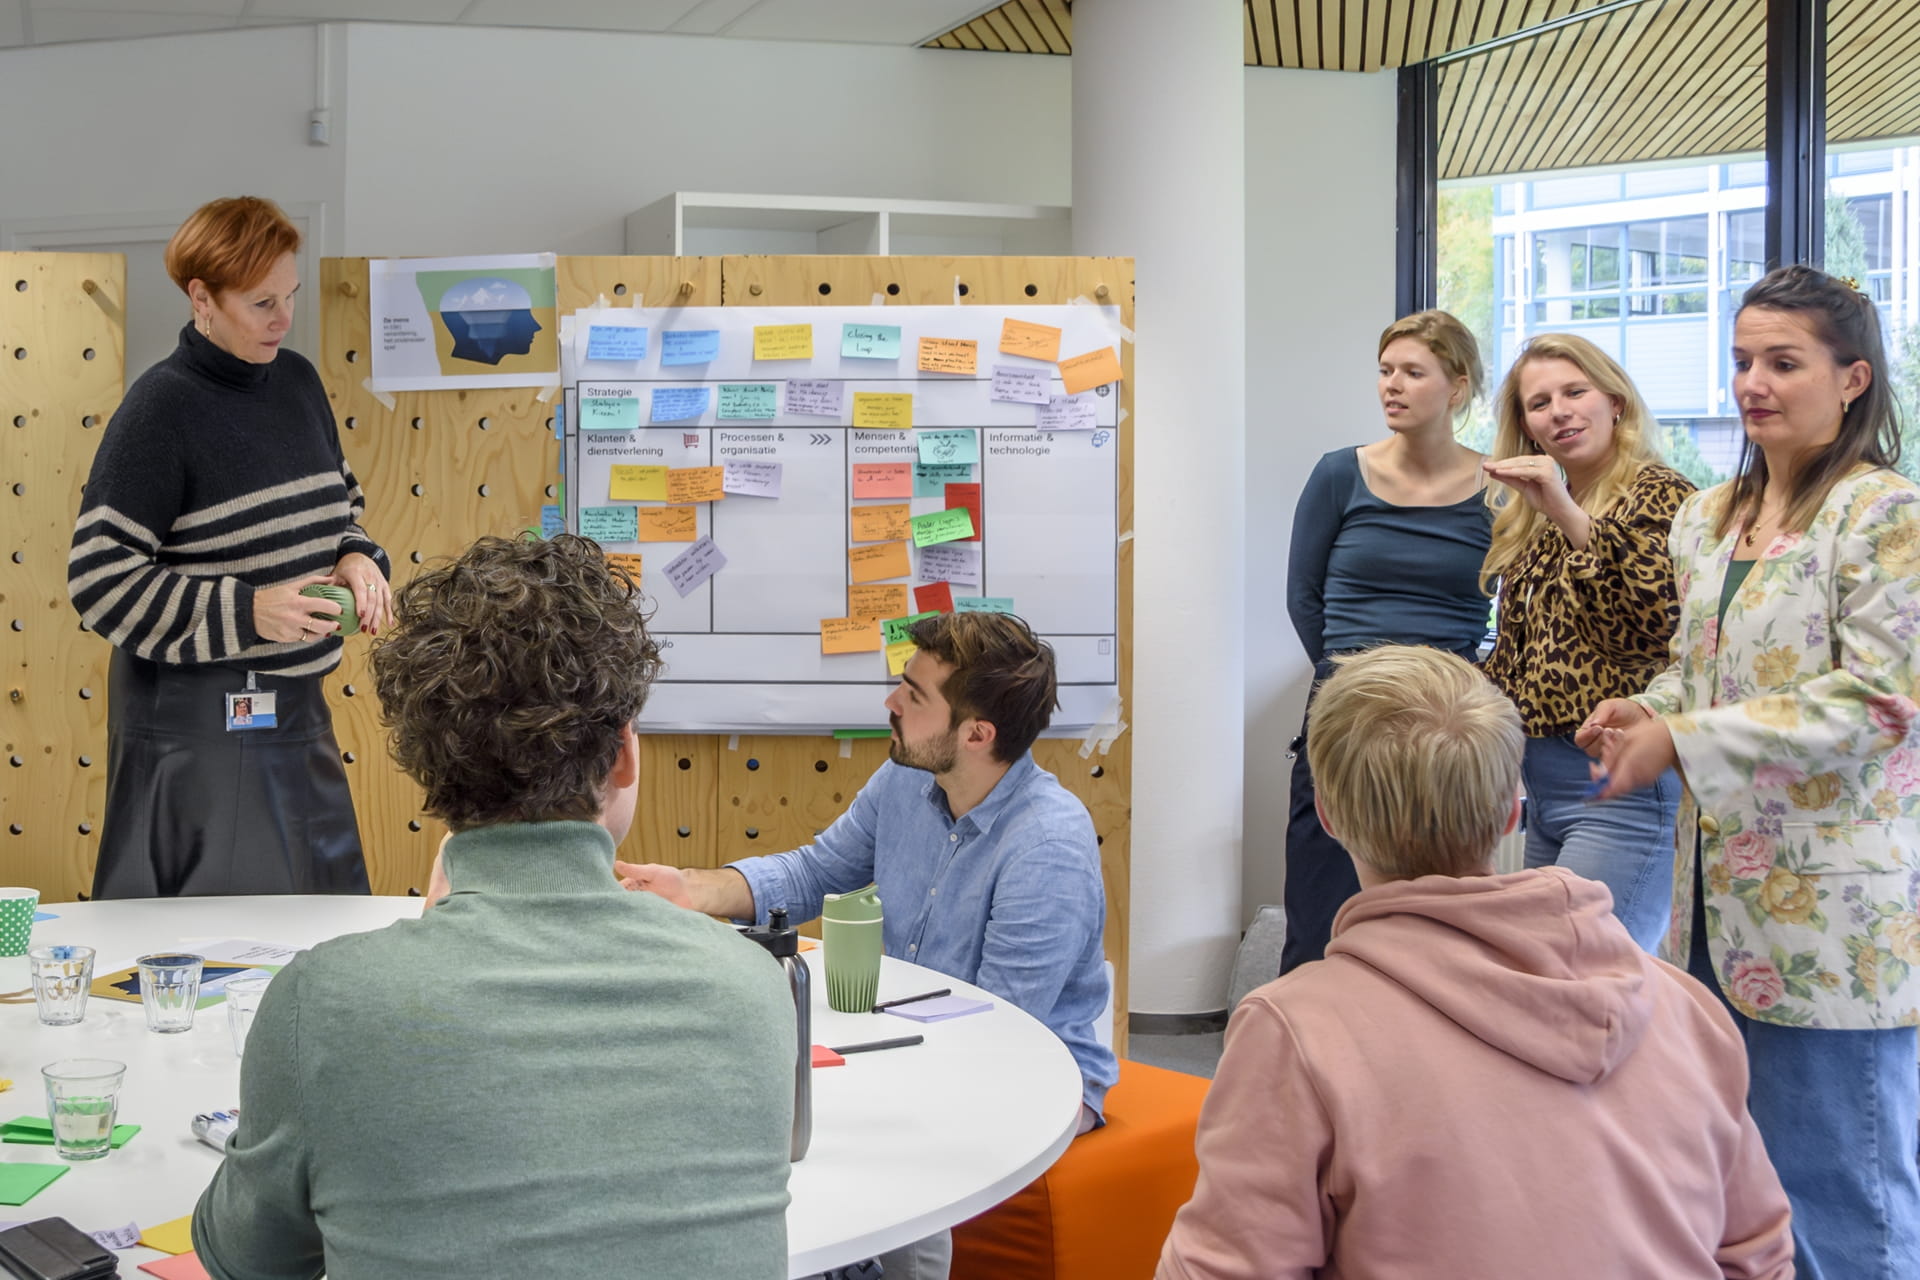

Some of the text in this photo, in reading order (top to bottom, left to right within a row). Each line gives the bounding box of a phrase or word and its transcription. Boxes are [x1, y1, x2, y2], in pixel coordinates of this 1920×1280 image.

[587, 387, 633, 398] Strategie
[587, 433, 636, 443] Klanten &
[720, 432, 785, 442] Processen &
[854, 431, 906, 441] Mensen &
[989, 432, 1054, 442] Informatie &
[587, 446, 664, 457] dienstverlening
[720, 445, 777, 456] organisatie
[854, 445, 919, 456] competentie
[989, 446, 1051, 456] technologie
